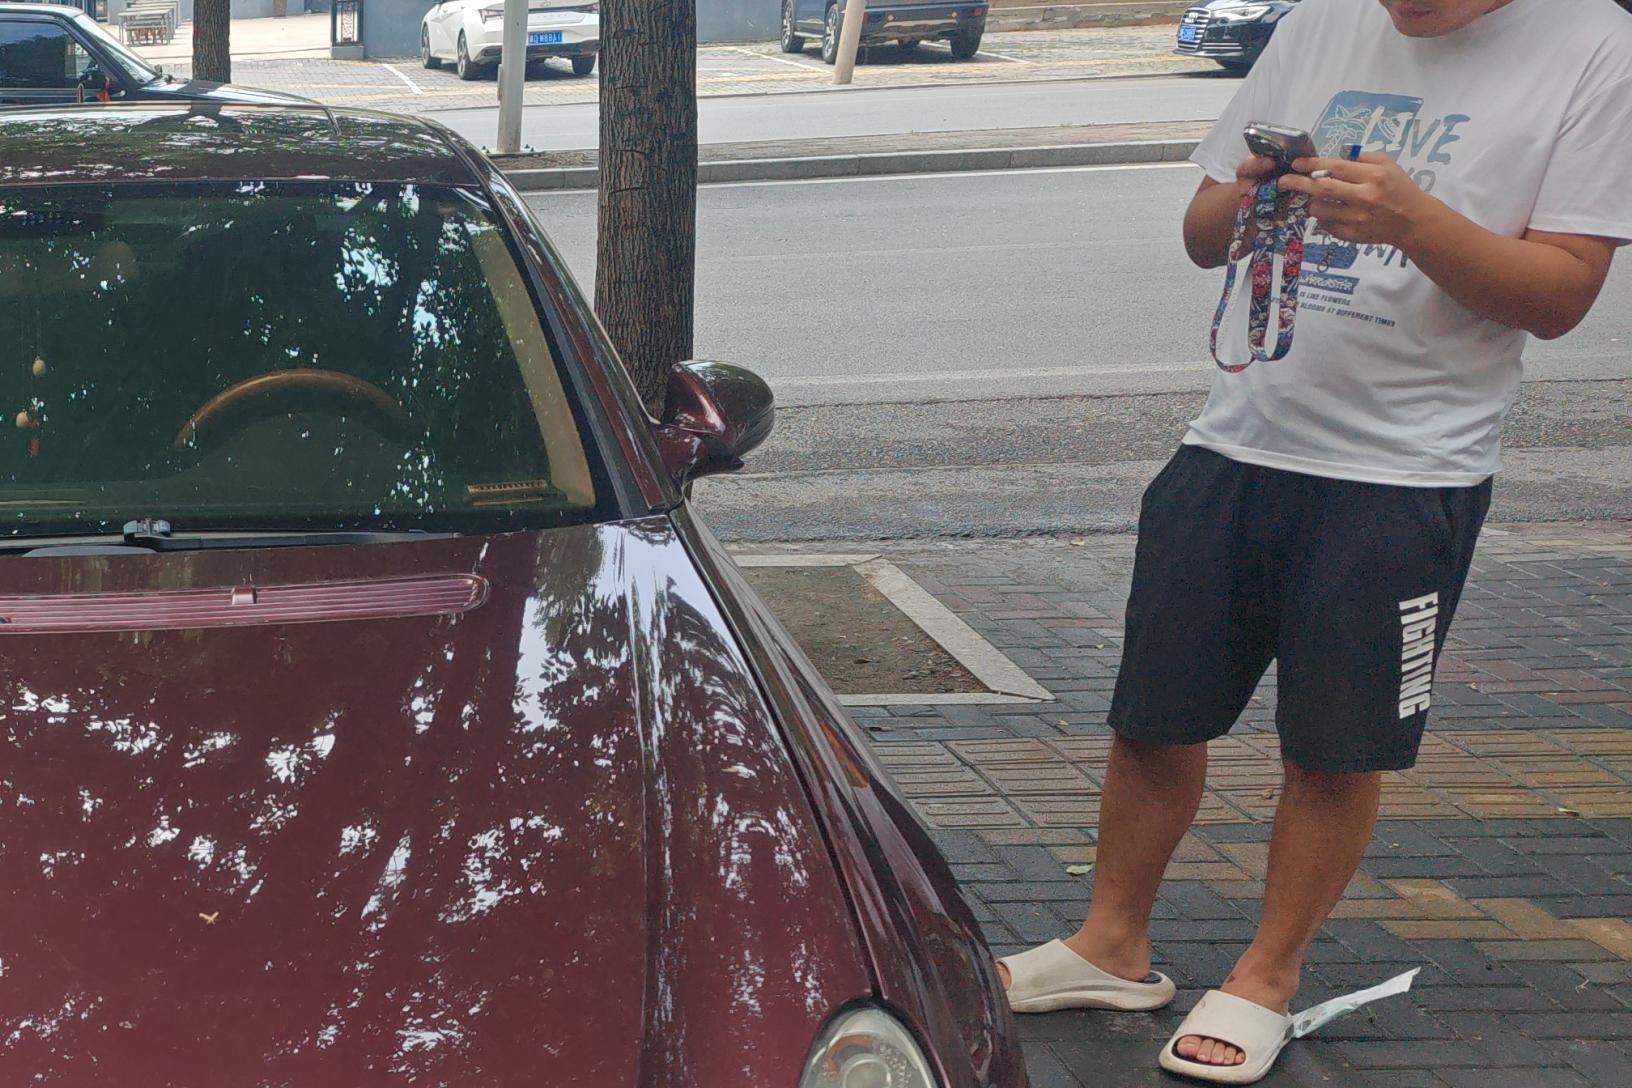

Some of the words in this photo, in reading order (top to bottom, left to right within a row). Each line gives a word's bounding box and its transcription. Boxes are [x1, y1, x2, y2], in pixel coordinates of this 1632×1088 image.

[1359, 104, 1471, 165] LIVE
[1306, 292, 1319, 300] LIKE
[1320, 294, 1351, 306] FLOWERS
[1335, 308, 1374, 323] DIFFERENT
[1374, 315, 1396, 328] TIMES
[1398, 591, 1439, 720] FIGHTING
